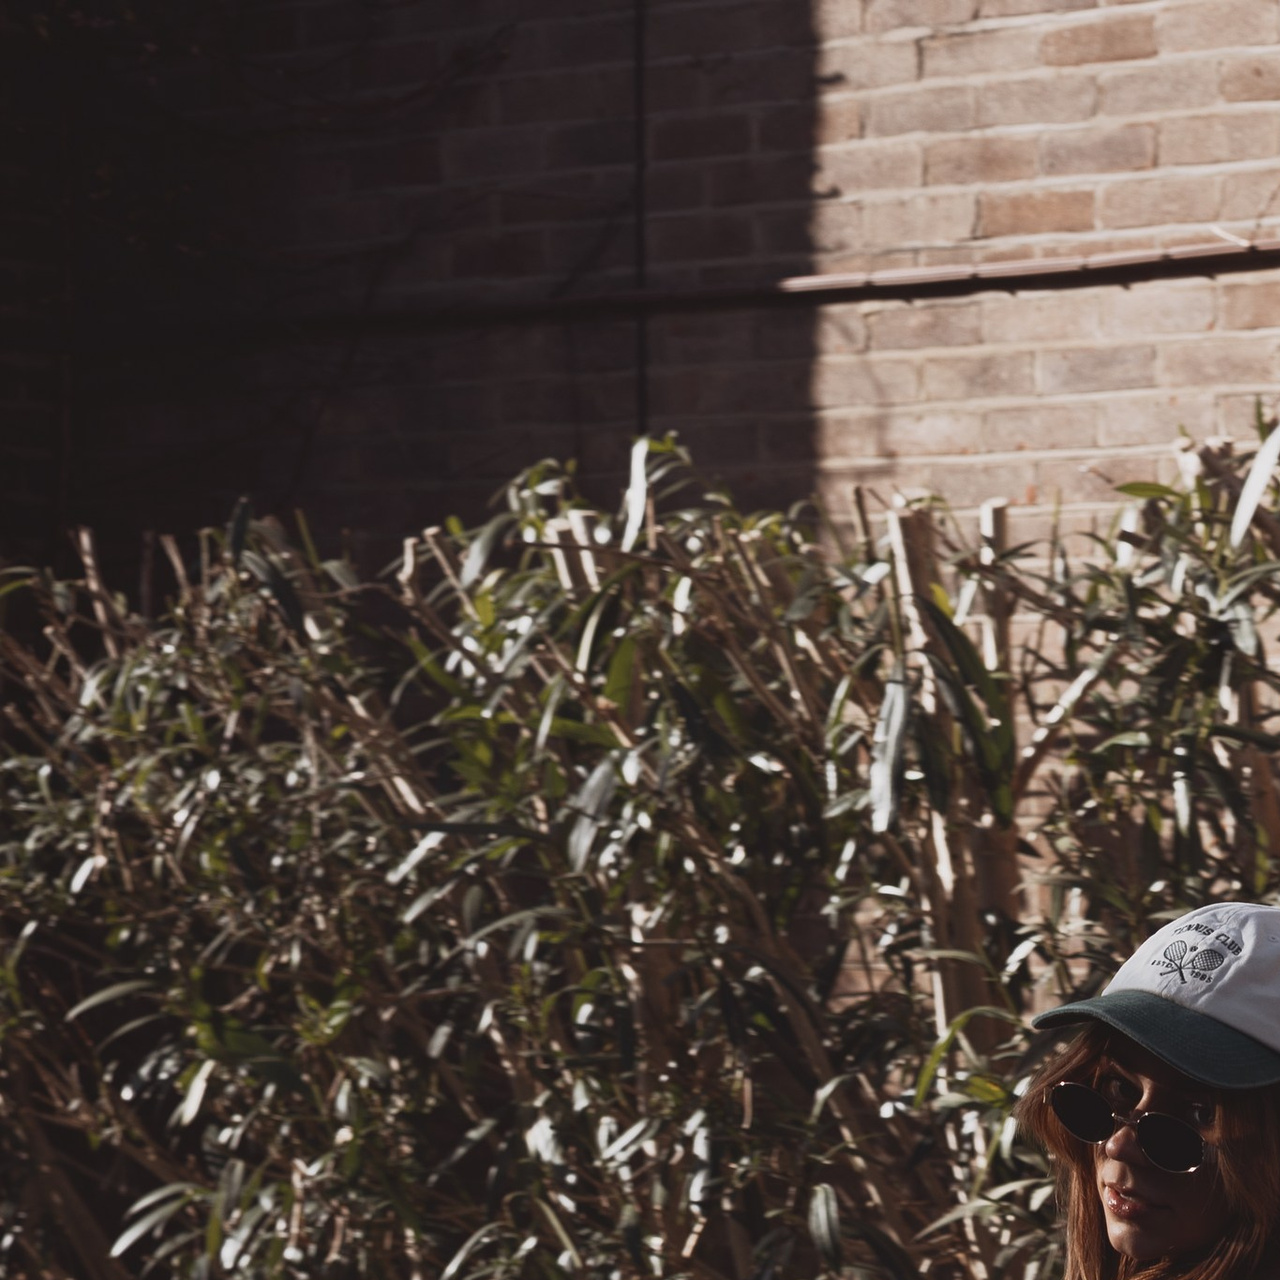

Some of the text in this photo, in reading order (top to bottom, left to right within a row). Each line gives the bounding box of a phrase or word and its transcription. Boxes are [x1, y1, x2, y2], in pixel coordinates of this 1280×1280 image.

[1171, 923, 1242, 956] TENNIS CLUB
[1190, 970, 1213, 983] 1985
